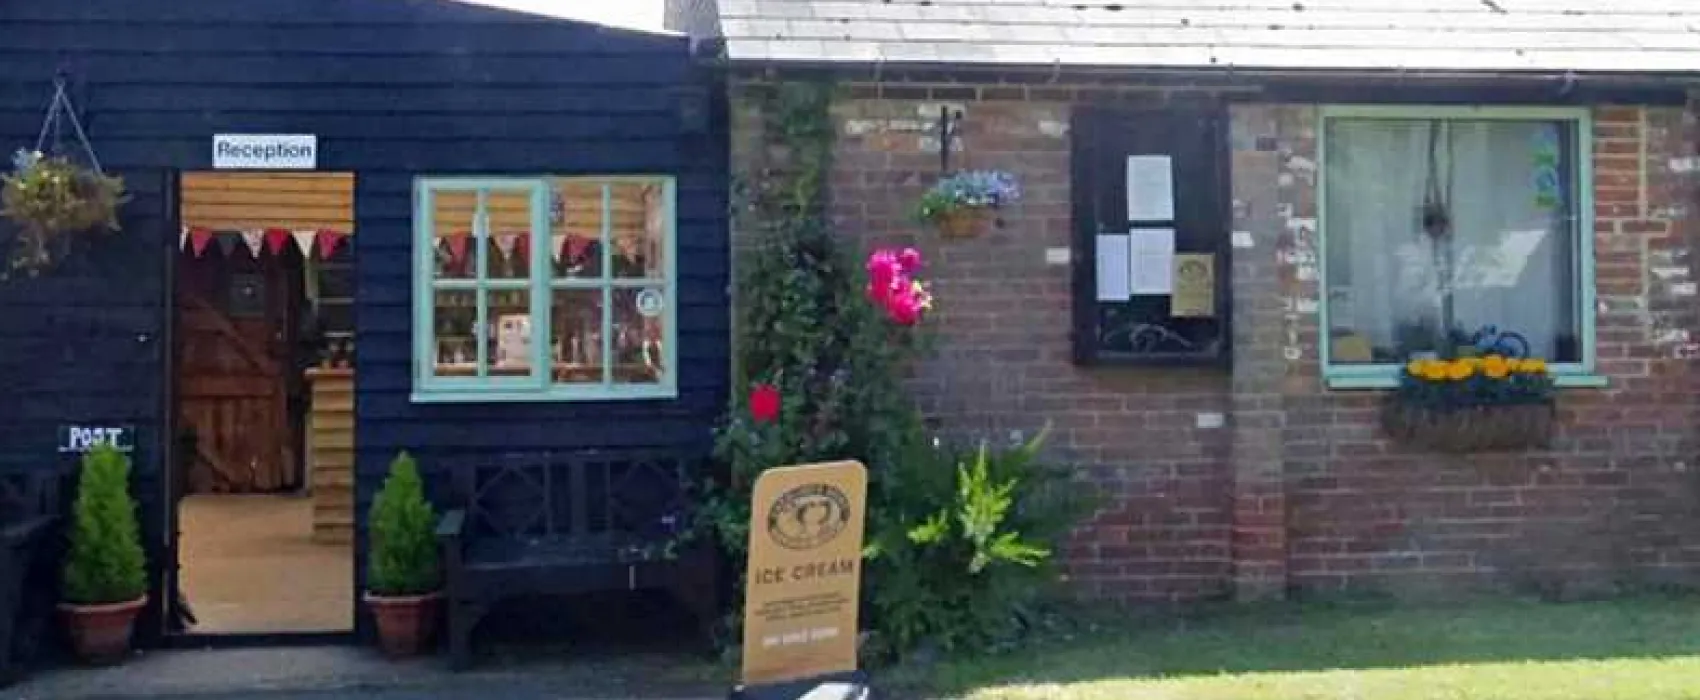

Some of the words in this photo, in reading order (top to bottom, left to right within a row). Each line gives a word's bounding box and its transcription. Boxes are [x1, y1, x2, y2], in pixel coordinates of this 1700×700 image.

[217, 141, 312, 162] Reception
[69, 427, 123, 448] POST
[755, 566, 784, 584] ICE
[791, 560, 853, 581] CREAM
